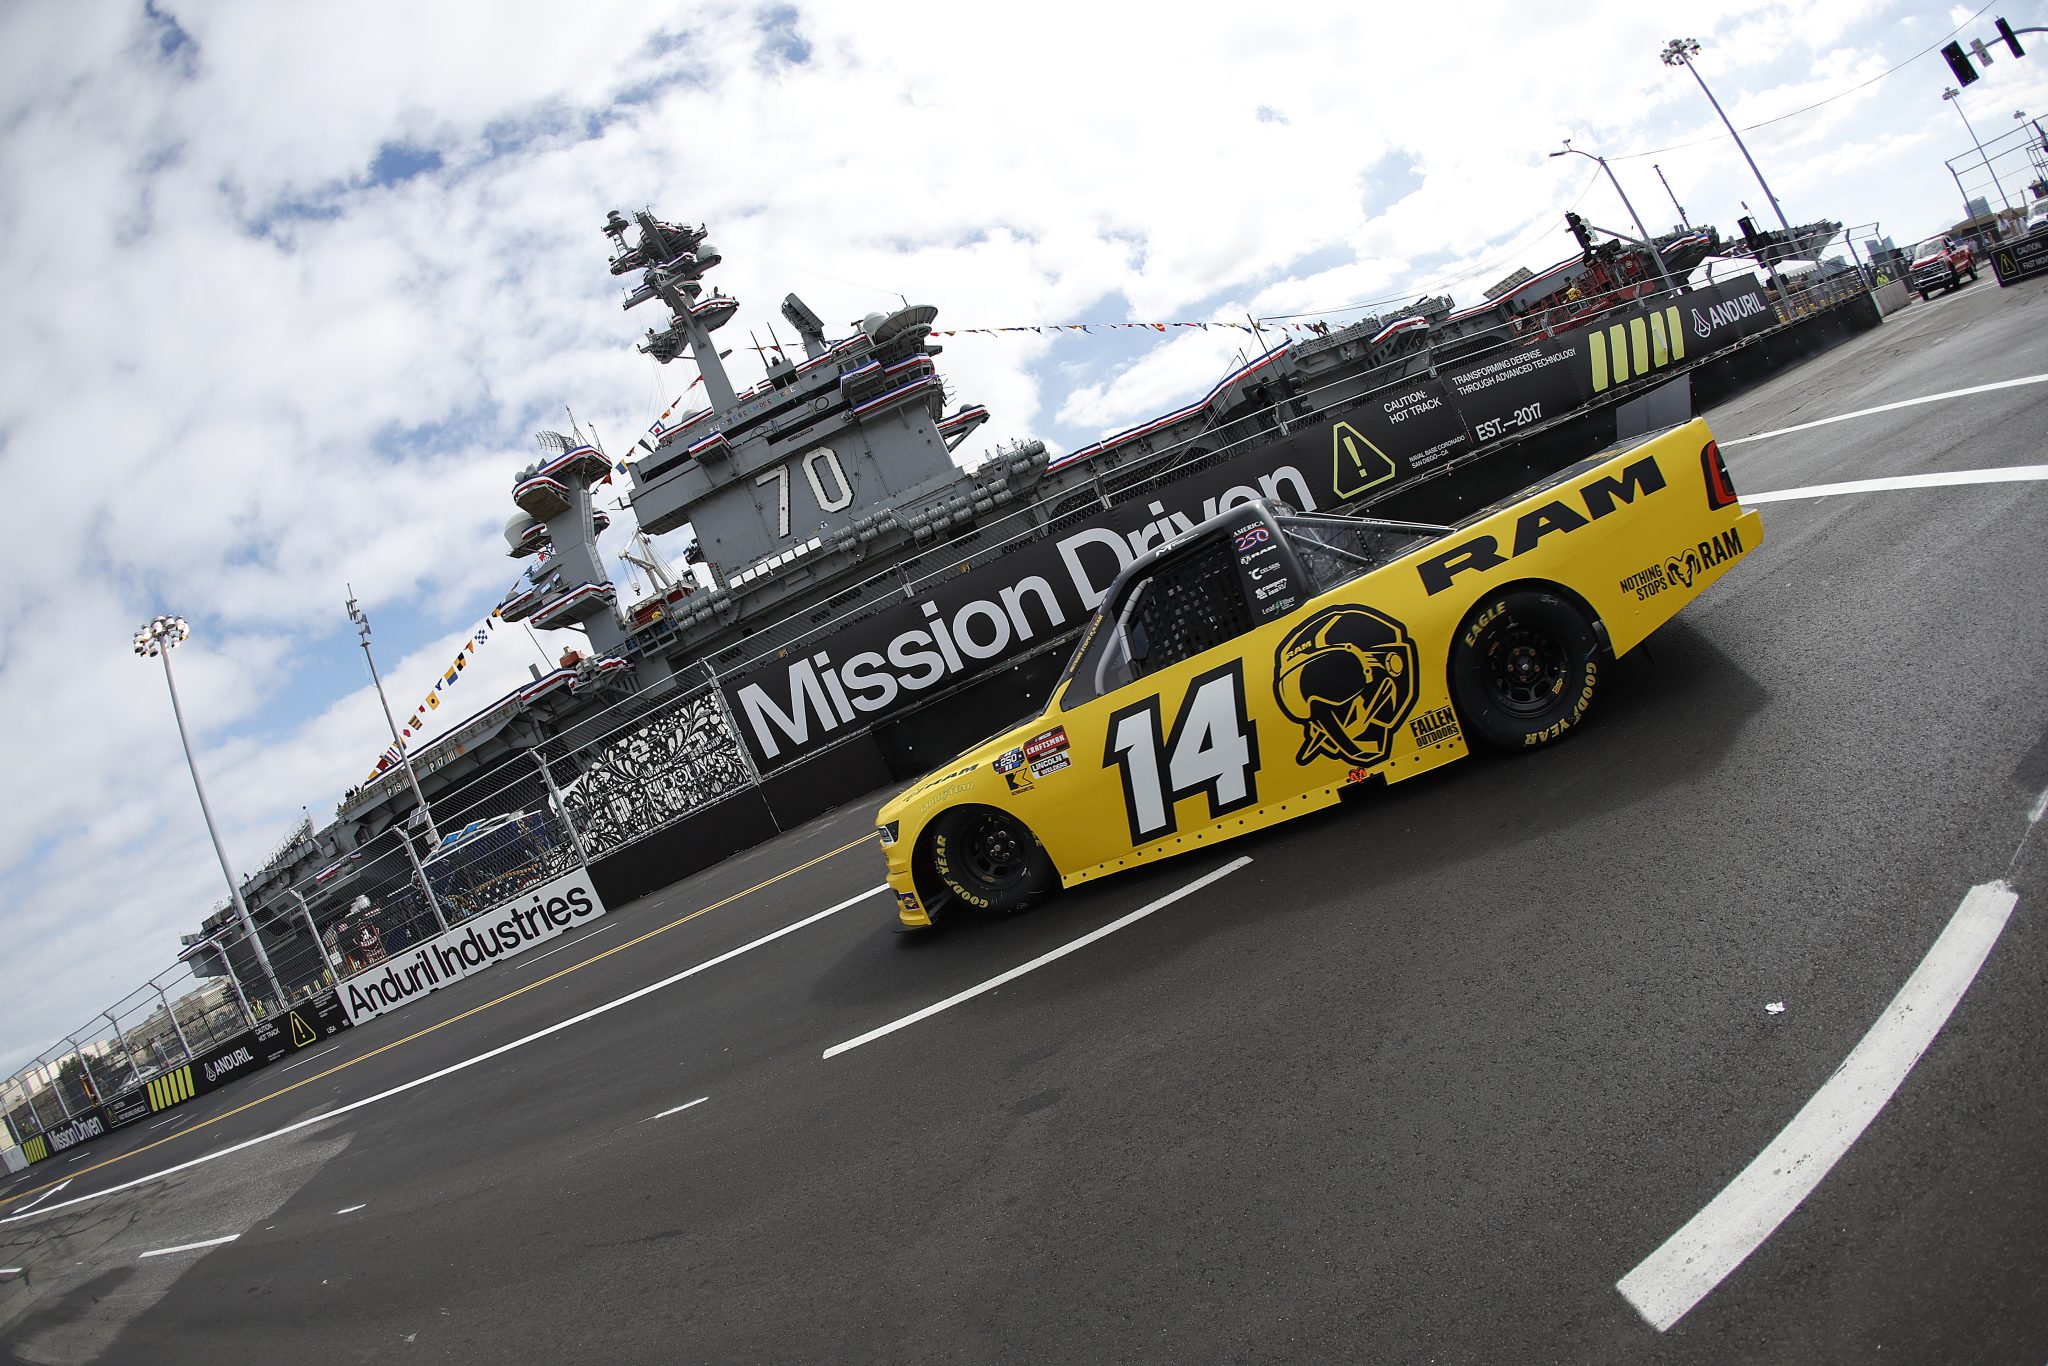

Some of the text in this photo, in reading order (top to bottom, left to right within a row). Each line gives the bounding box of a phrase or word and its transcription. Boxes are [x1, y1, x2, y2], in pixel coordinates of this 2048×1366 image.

[1709, 292, 1766, 329] ANDURIL
[1452, 348, 1542, 385] TRANSFORMING DEFENSE
[1457, 347, 1577, 396] THROUGH ADVANCED TECHNOLOGY
[1383, 390, 1427, 413] CAUTION:
[1389, 396, 1442, 425] HOT TRACK
[1408, 434, 1466, 462] NAVAL BASE CORONADO
[1411, 460, 1423, 469] SAN
[755, 447, 855, 538] 70
[1233, 520, 1264, 538] AMERICA
[1415, 454, 1667, 597] RAM
[1251, 544, 1277, 559] RAM
[1697, 527, 1744, 570] RAM
[1619, 563, 1663, 594] NOTHING
[1636, 576, 1668, 601] STOPS
[1464, 600, 1506, 648] EAGLE
[738, 576, 1064, 759] Mission
[1410, 706, 1457, 738] FALLEN
[1416, 722, 1460, 748] OUTDOORS
[1000, 753, 1017, 766] 250
[1026, 734, 1065, 755] CRAFTSMAN
[1107, 663, 1254, 841] 14
[1031, 753, 1063, 772] LINCOLN
[1041, 760, 1068, 775] WELDERS
[347, 886, 593, 1019] Anduril Industries
[214, 1046, 254, 1076] ANDURIL
[47, 1115, 104, 1152] Mission Driven
